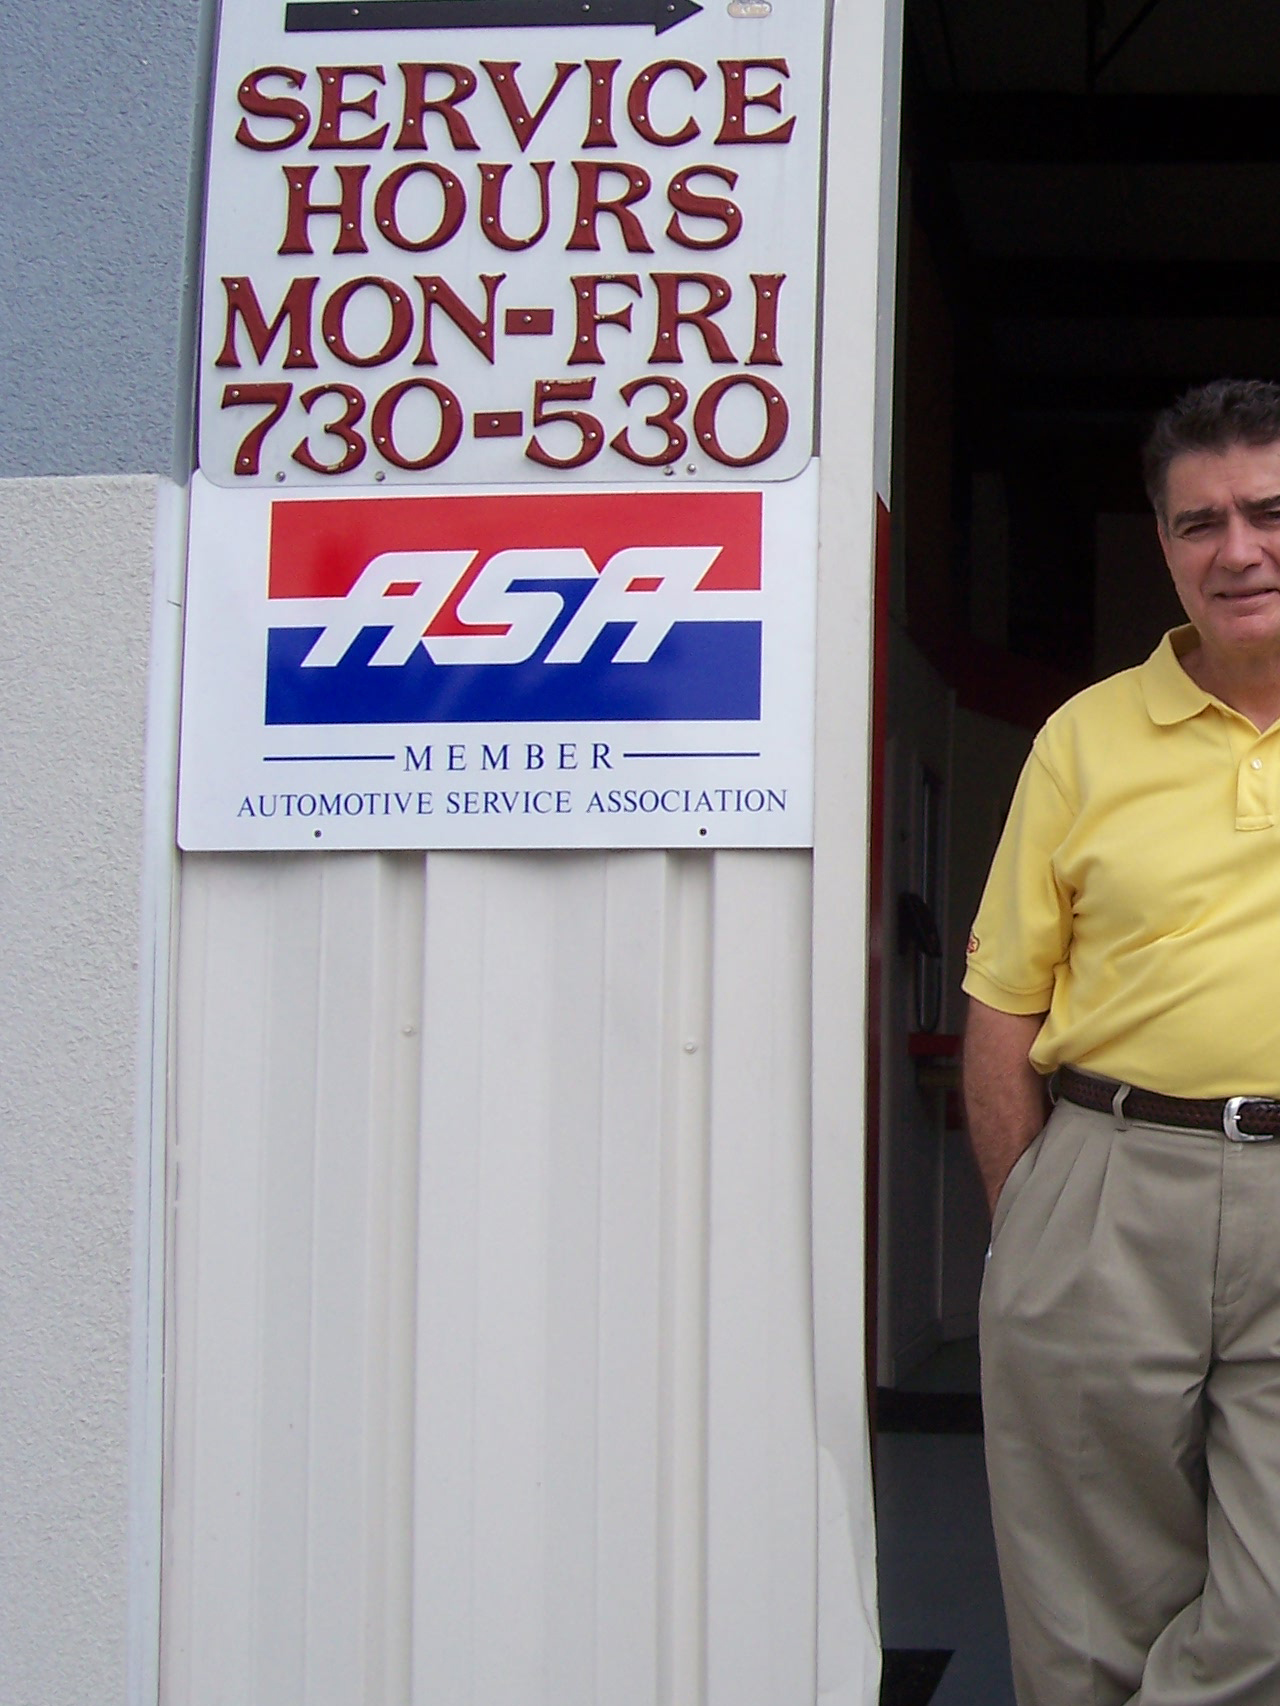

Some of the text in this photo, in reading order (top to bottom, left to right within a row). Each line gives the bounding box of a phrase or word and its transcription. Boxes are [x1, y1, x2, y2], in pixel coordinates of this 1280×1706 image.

[235, 57, 798, 152] SERVICE
[278, 159, 744, 255] HOURS
[214, 272, 787, 369] MON-FRI
[221, 373, 790, 476] 730-530
[301, 546, 724, 668] ASA
[237, 787, 787, 818] AUTOMOTIVE SERVICE ASSOCIATION
[403, 742, 614, 772] MEMBER
